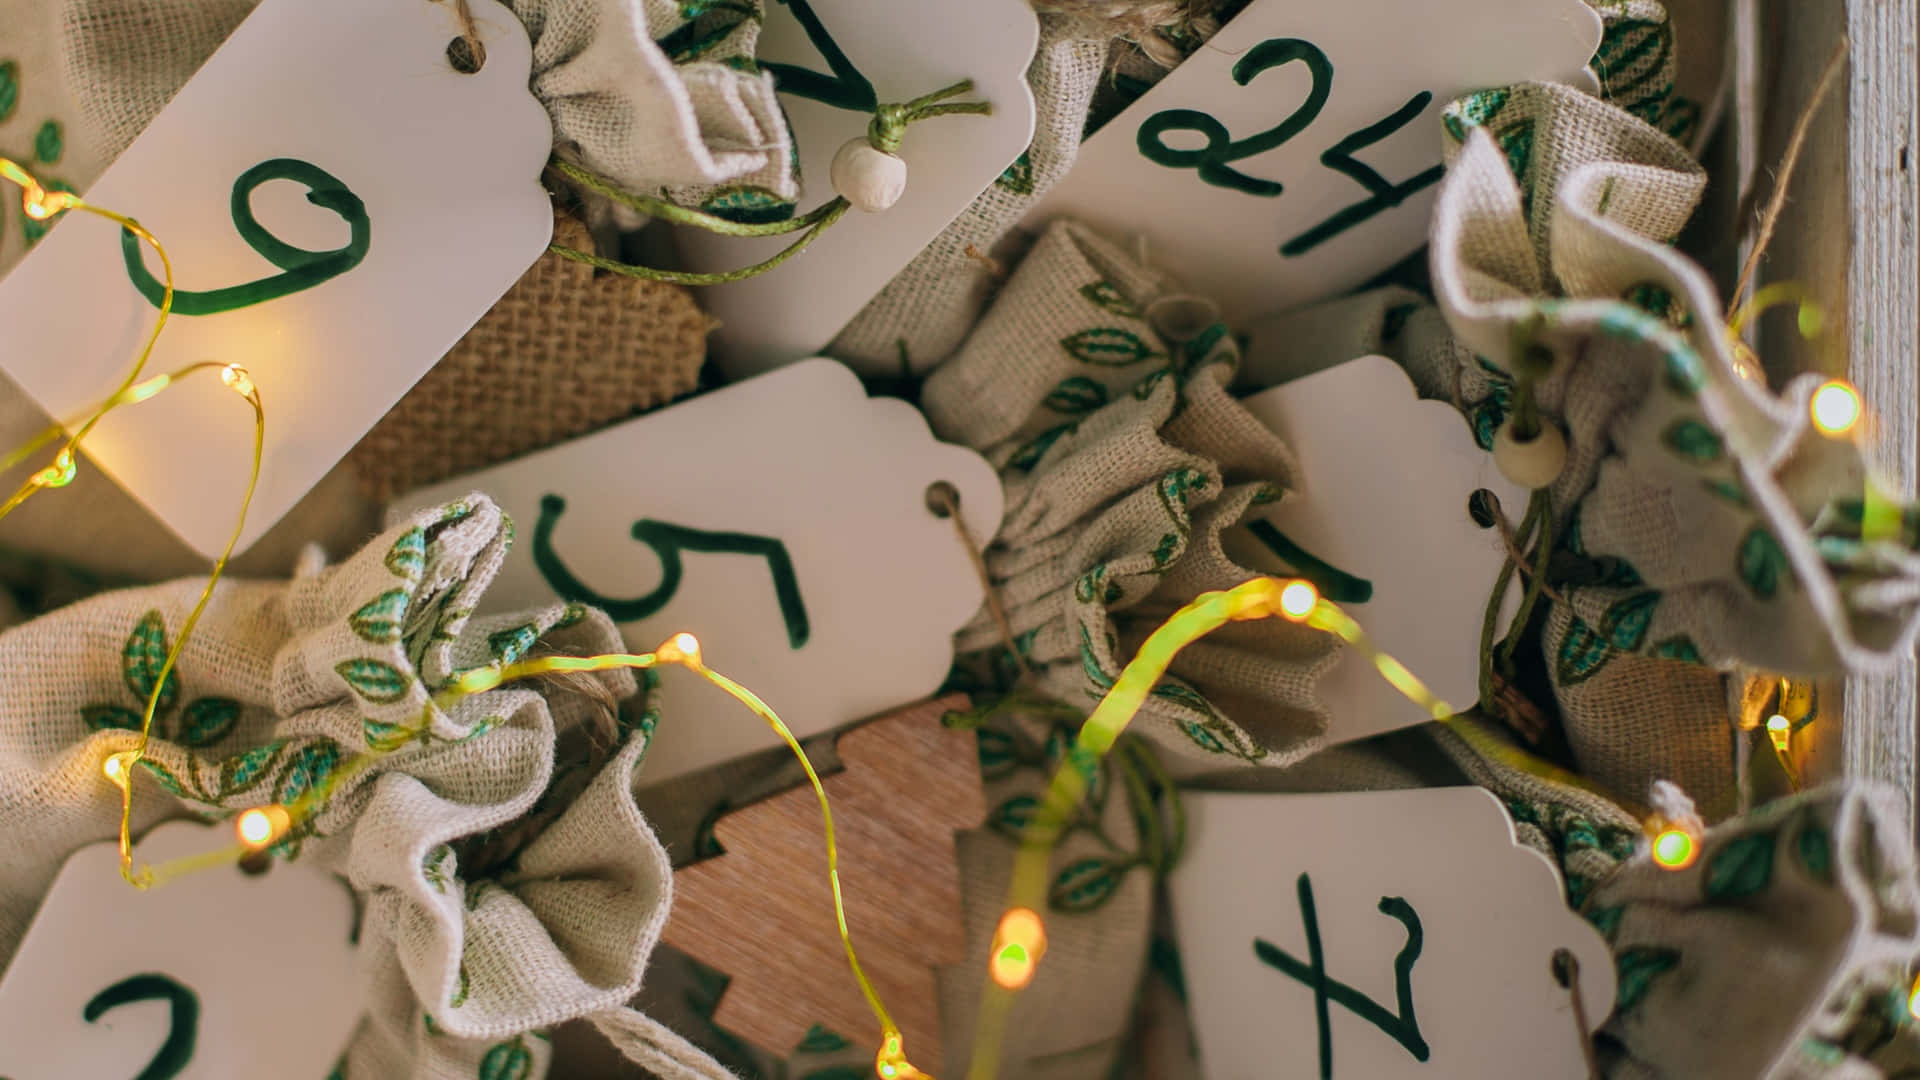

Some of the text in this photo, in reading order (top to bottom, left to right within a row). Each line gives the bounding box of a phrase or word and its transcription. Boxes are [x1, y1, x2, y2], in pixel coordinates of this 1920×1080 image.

[1136, 37, 1447, 258] 24
[121, 157, 371, 315] 9
[532, 494, 811, 650] 5
